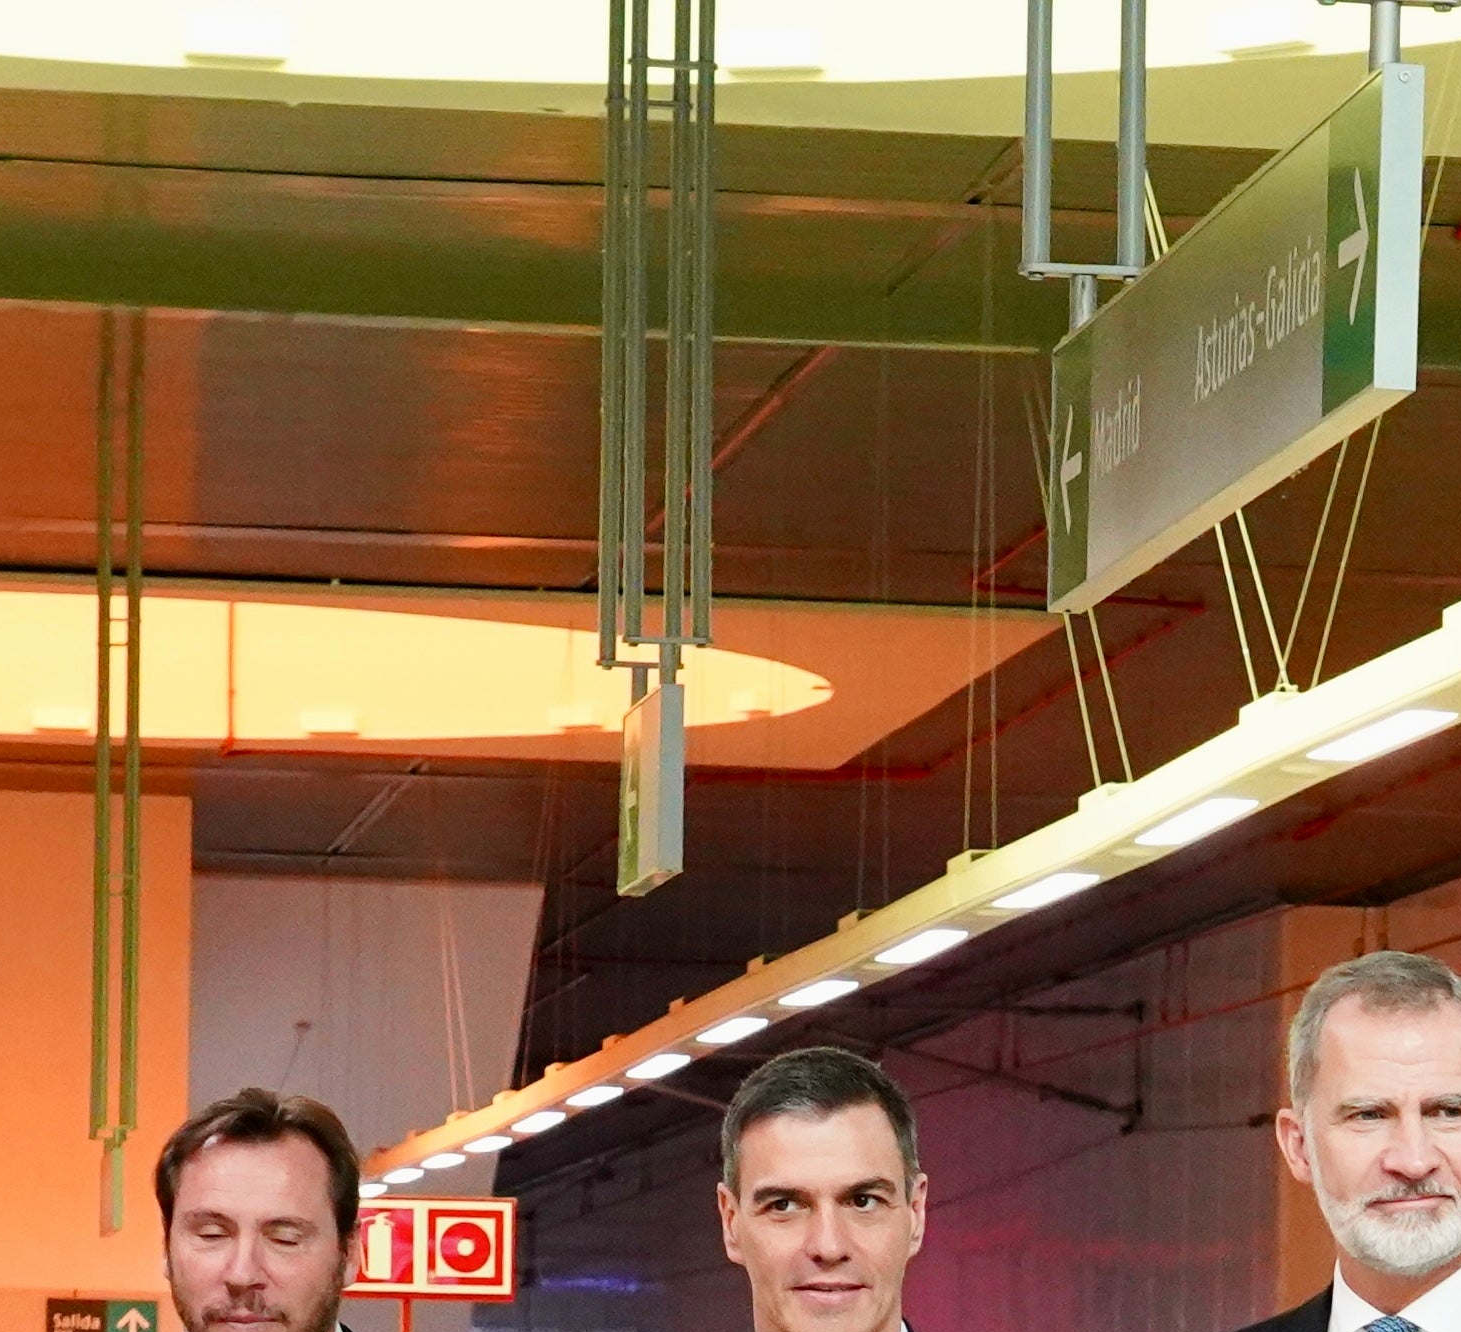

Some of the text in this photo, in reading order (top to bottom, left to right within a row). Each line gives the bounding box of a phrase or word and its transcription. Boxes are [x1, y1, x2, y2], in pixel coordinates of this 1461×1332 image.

[1194, 235, 1320, 402] Asturias-Galicia
[1094, 374, 1140, 481] Madrid
[52, 1313, 101, 1330] Salida
